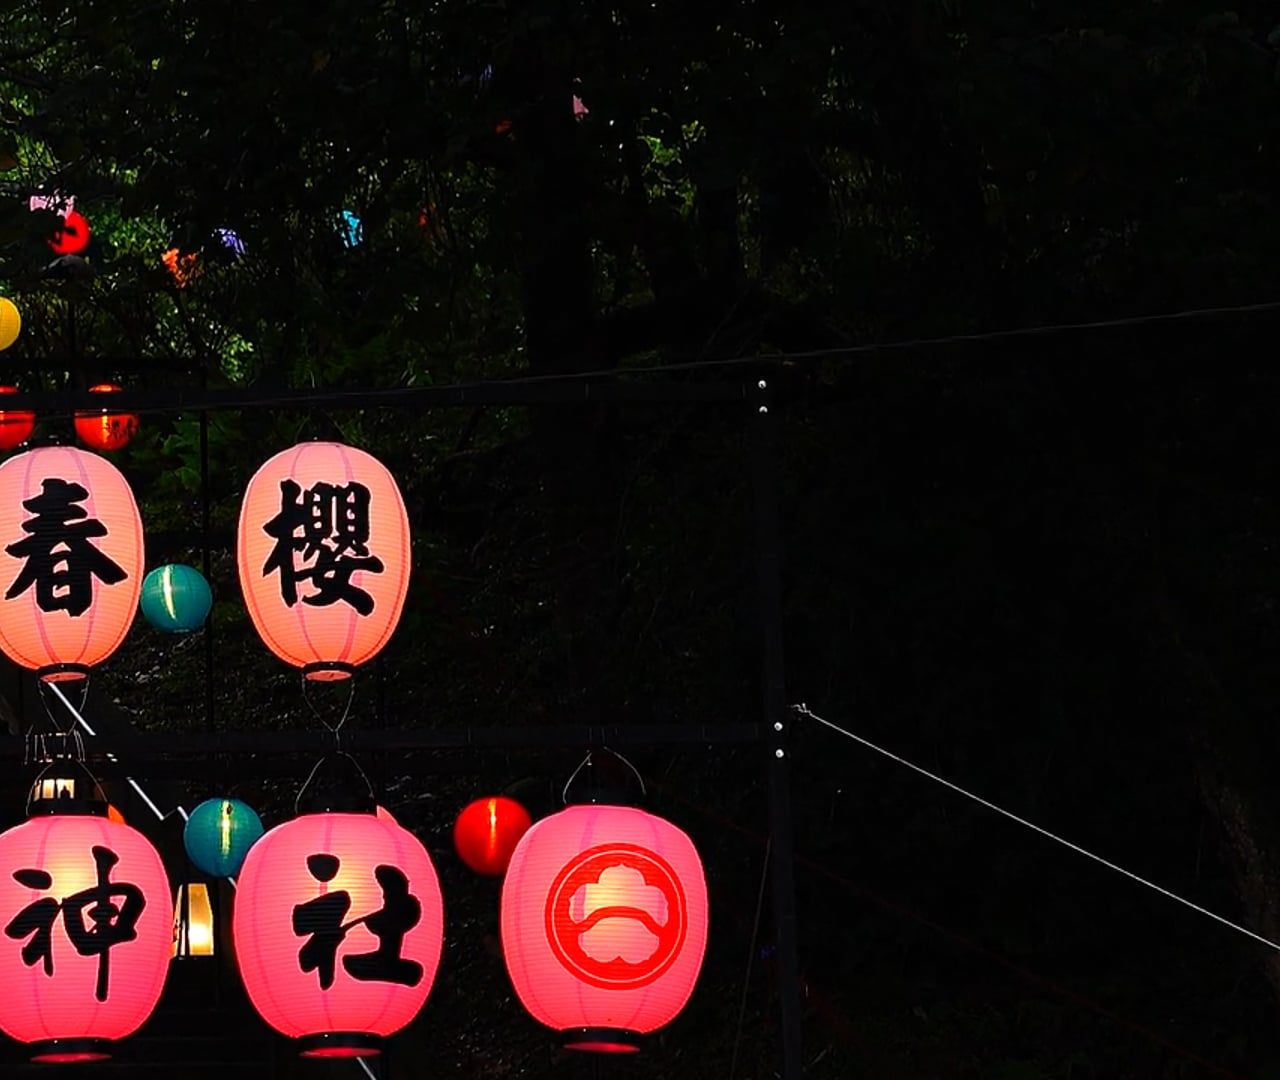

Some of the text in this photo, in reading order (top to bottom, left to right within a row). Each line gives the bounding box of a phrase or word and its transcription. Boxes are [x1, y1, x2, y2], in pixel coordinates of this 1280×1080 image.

[4, 478, 128, 617] 春
[262, 479, 385, 617] 櫻
[4, 846, 147, 1002] 神
[292, 854, 424, 990] 社
